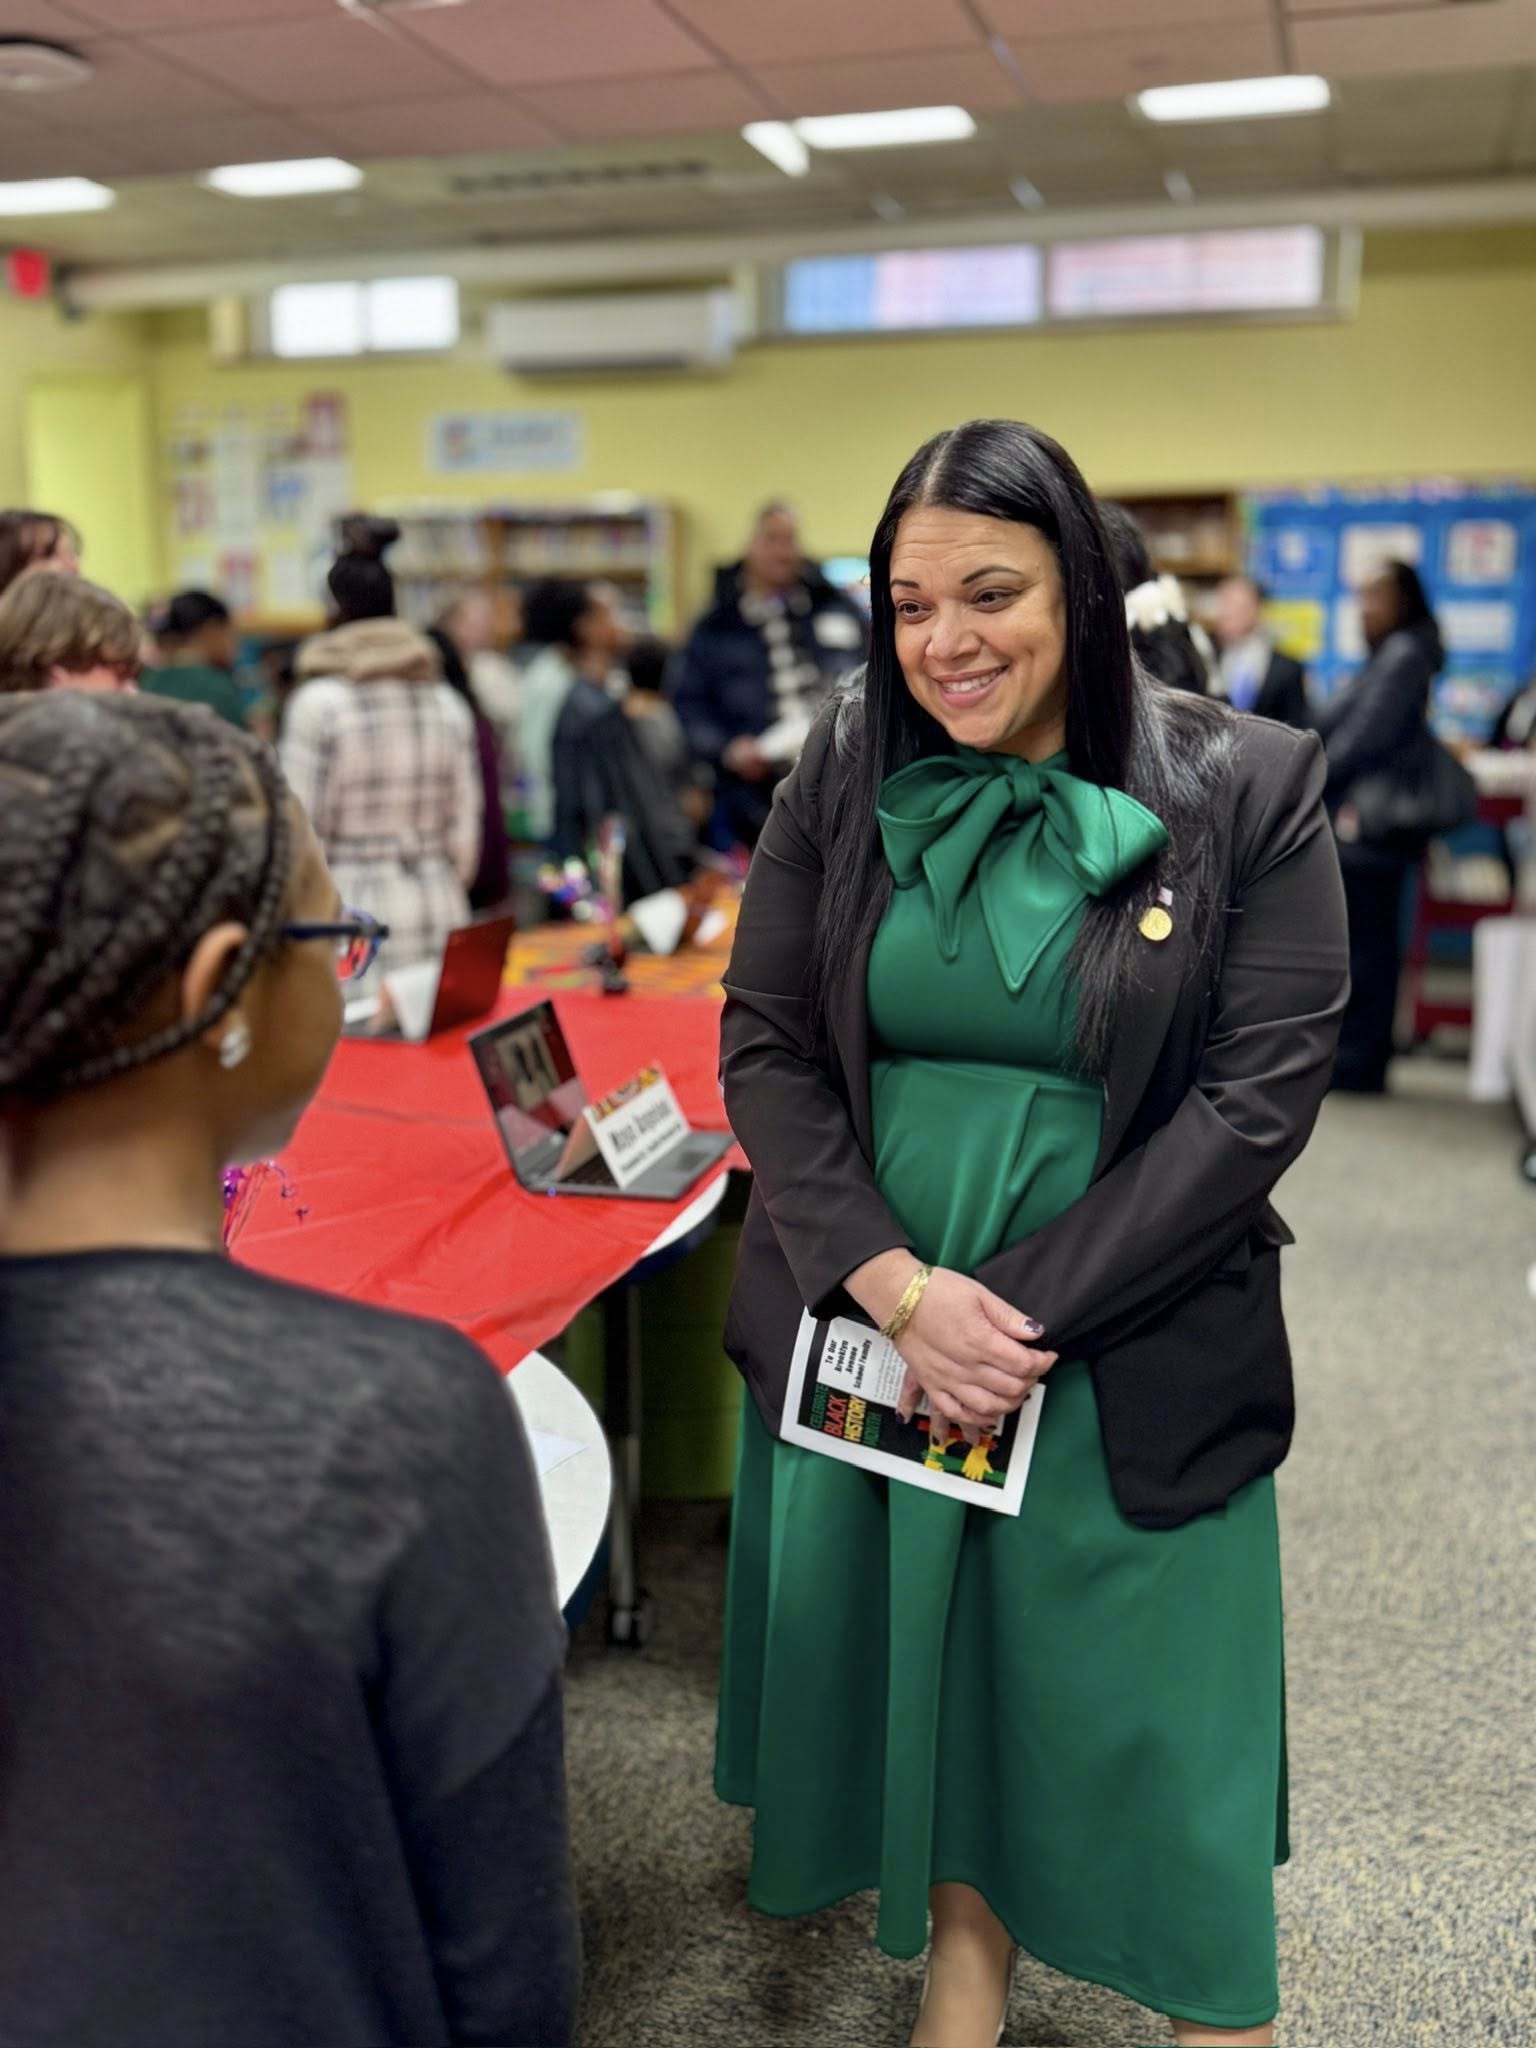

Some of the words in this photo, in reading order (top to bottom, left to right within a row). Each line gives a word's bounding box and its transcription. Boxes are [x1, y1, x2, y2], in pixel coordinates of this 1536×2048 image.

[825, 1354, 834, 1365] To
[827, 1339, 838, 1354] Our
[834, 1340, 849, 1373] Brooklyn
[845, 1346, 858, 1374] Avenue
[853, 1364, 865, 1389] School
[859, 1338, 873, 1364] Family
[810, 1383, 829, 1429] CELEBRATE
[823, 1394, 848, 1438] BLACK
[843, 1394, 867, 1442] HISTORY
[863, 1411, 881, 1447] MONTH
